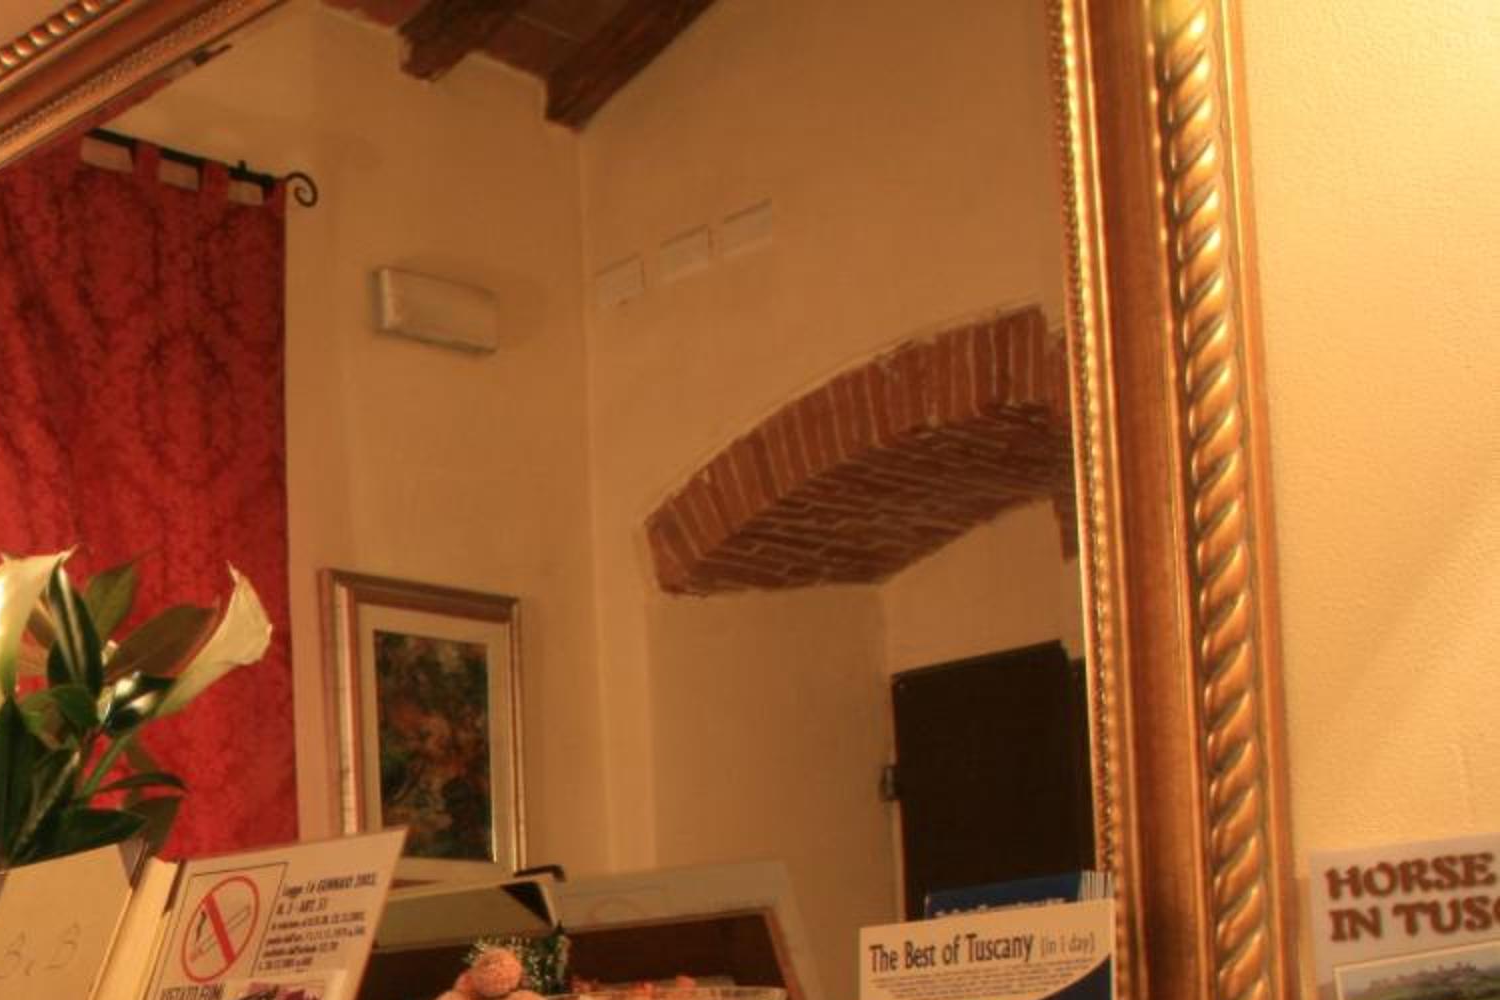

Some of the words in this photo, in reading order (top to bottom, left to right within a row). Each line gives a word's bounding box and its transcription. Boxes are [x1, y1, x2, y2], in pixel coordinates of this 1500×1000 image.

[1325, 852, 1497, 900] HORSE
[1329, 906, 1383, 943] IN
[1392, 895, 1500, 937] TUS
[869, 944, 898, 973] The
[904, 940, 936, 970] Best
[942, 934, 961, 966] of
[965, 932, 1034, 963] Tuscany
